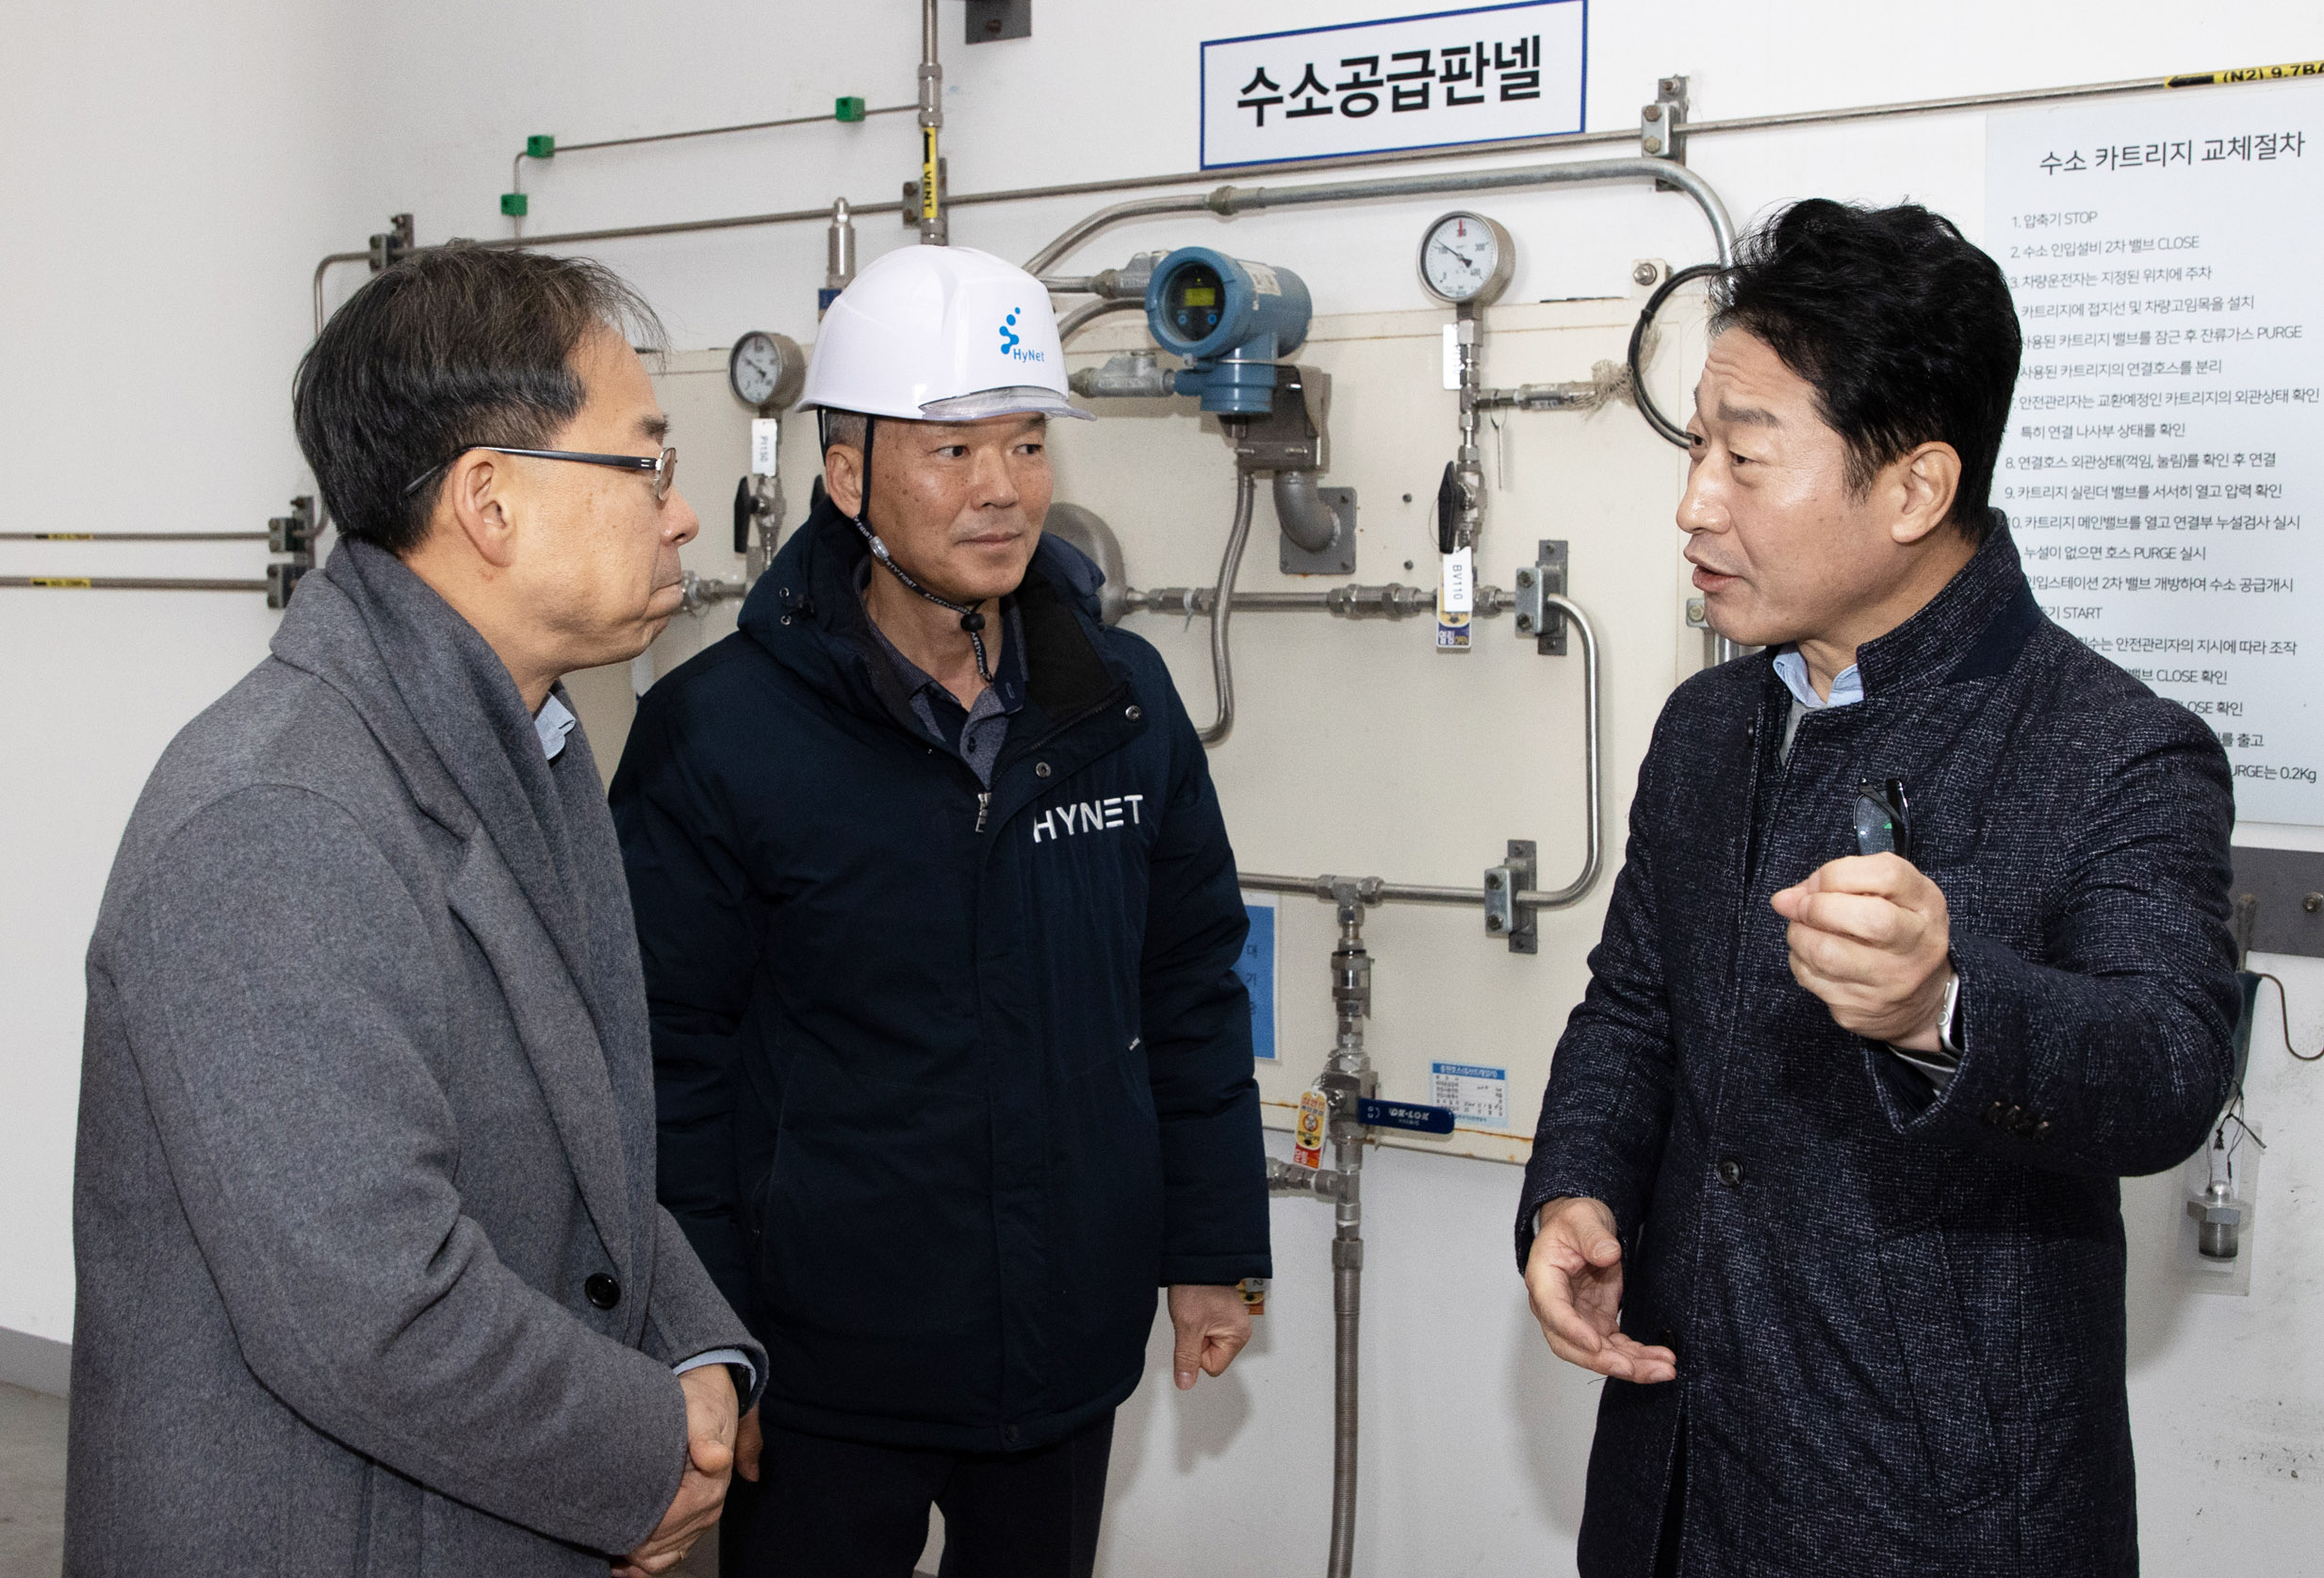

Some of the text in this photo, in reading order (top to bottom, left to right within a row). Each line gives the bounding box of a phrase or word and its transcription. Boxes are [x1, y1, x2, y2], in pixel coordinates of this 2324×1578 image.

[1237, 35, 1541, 127] 수소공급판넬
[2223, 69, 2265, 83] (N2)
[2039, 131, 2306, 175] 수소 카트리지 교체절차
[924, 171, 933, 208] VENT
[2024, 213, 2061, 228] 압축기
[2065, 211, 2098, 224] STOP
[2023, 245, 2048, 258] 수소
[2052, 241, 2102, 257] 인입설비
[2105, 239, 2126, 253] 2차
[2129, 238, 2154, 253] 밸브
[2158, 236, 2199, 250] CLOSE
[2022, 272, 2097, 289] 차량운전자는
[2102, 270, 2139, 285] 지정된
[2144, 268, 2182, 283] 위치에
[2185, 266, 2212, 281] 주차
[2022, 304, 2084, 319] 카트리지에
[2088, 302, 2125, 317] 접지선
[2129, 301, 2141, 315] 및
[2228, 295, 2253, 311] 설치
[2022, 325, 2302, 350] 사용된 카트리지 밸브를 잠근 후 잔류가스 PURGE
[1013, 348, 1045, 363] HyNet
[2021, 360, 2221, 379] 사용된 카트리지의 연결호스를 분리
[2020, 395, 2094, 410] 안전관리자는
[2098, 392, 2162, 407] 교환예정인
[2166, 390, 2232, 406] 카트리지의
[2234, 388, 2289, 404] 외관상태
[2292, 387, 2319, 403] 확인
[2021, 423, 2185, 439] 특히 연결 나사부 상태를 확인
[2019, 456, 2068, 470] 연결호스
[2202, 452, 2229, 468] 확인
[2232, 452, 2246, 467] 후
[2249, 452, 2276, 468] 연결
[2019, 485, 2067, 500] 카트리지
[2070, 485, 2108, 500] 실린더
[2111, 485, 2151, 500] 밸브를
[2152, 485, 2192, 499] 서서히
[2195, 485, 2222, 499] 열고
[2225, 484, 2251, 499] 압력
[2255, 484, 2282, 499] 확인
[2025, 516, 2074, 530] 카트리지
[2078, 516, 2142, 530] 메인밸브를
[2145, 516, 2170, 531] 열고
[2173, 516, 2213, 530] 연결부
[2216, 515, 2269, 531] 누설검사
[2273, 515, 2299, 531] 실시
[2024, 546, 2205, 561] 누설이 없으면 호스 PURGE 실시
[1452, 565, 1463, 600] BV110
[2102, 576, 2123, 590] 2차
[2125, 577, 2152, 591] 밸브
[2154, 577, 2206, 592] 개방하여
[2210, 578, 2236, 591] 수소
[2239, 578, 2293, 593] 공급개시
[2063, 607, 2103, 619] START
[2116, 637, 2194, 653] 안전관리자의
[2197, 639, 2236, 654] 지시에
[2239, 640, 2267, 655] 따라
[2269, 641, 2298, 656] 조작
[2156, 669, 2198, 682] CLOSE
[2201, 669, 2227, 685] 확인
[2217, 701, 2243, 716] 확인
[2236, 732, 2264, 748] 출고
[2280, 766, 2316, 784] 0.2Kg
[1034, 795, 1143, 843] HYNET
